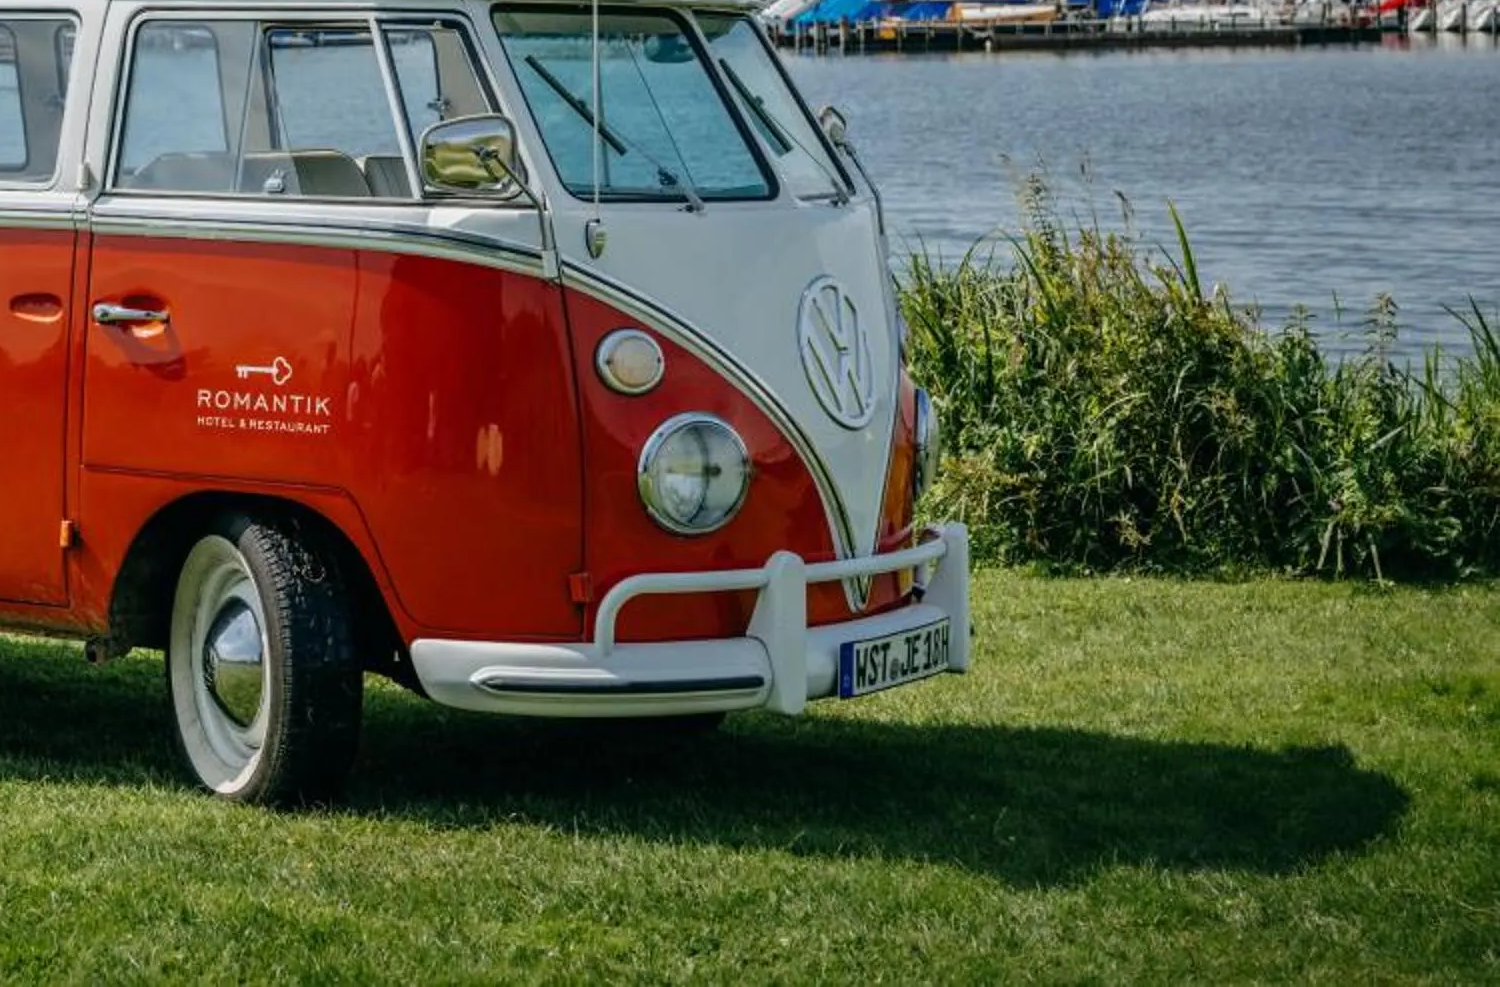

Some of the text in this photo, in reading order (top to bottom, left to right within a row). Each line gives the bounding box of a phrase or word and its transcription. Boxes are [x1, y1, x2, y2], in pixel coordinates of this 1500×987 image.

[797, 275, 874, 430] VW
[196, 388, 331, 416] ROMANTIK
[197, 415, 331, 434] HOTEL & RESTAURANT
[855, 641, 892, 689] WST
[900, 633, 922, 676] JE
